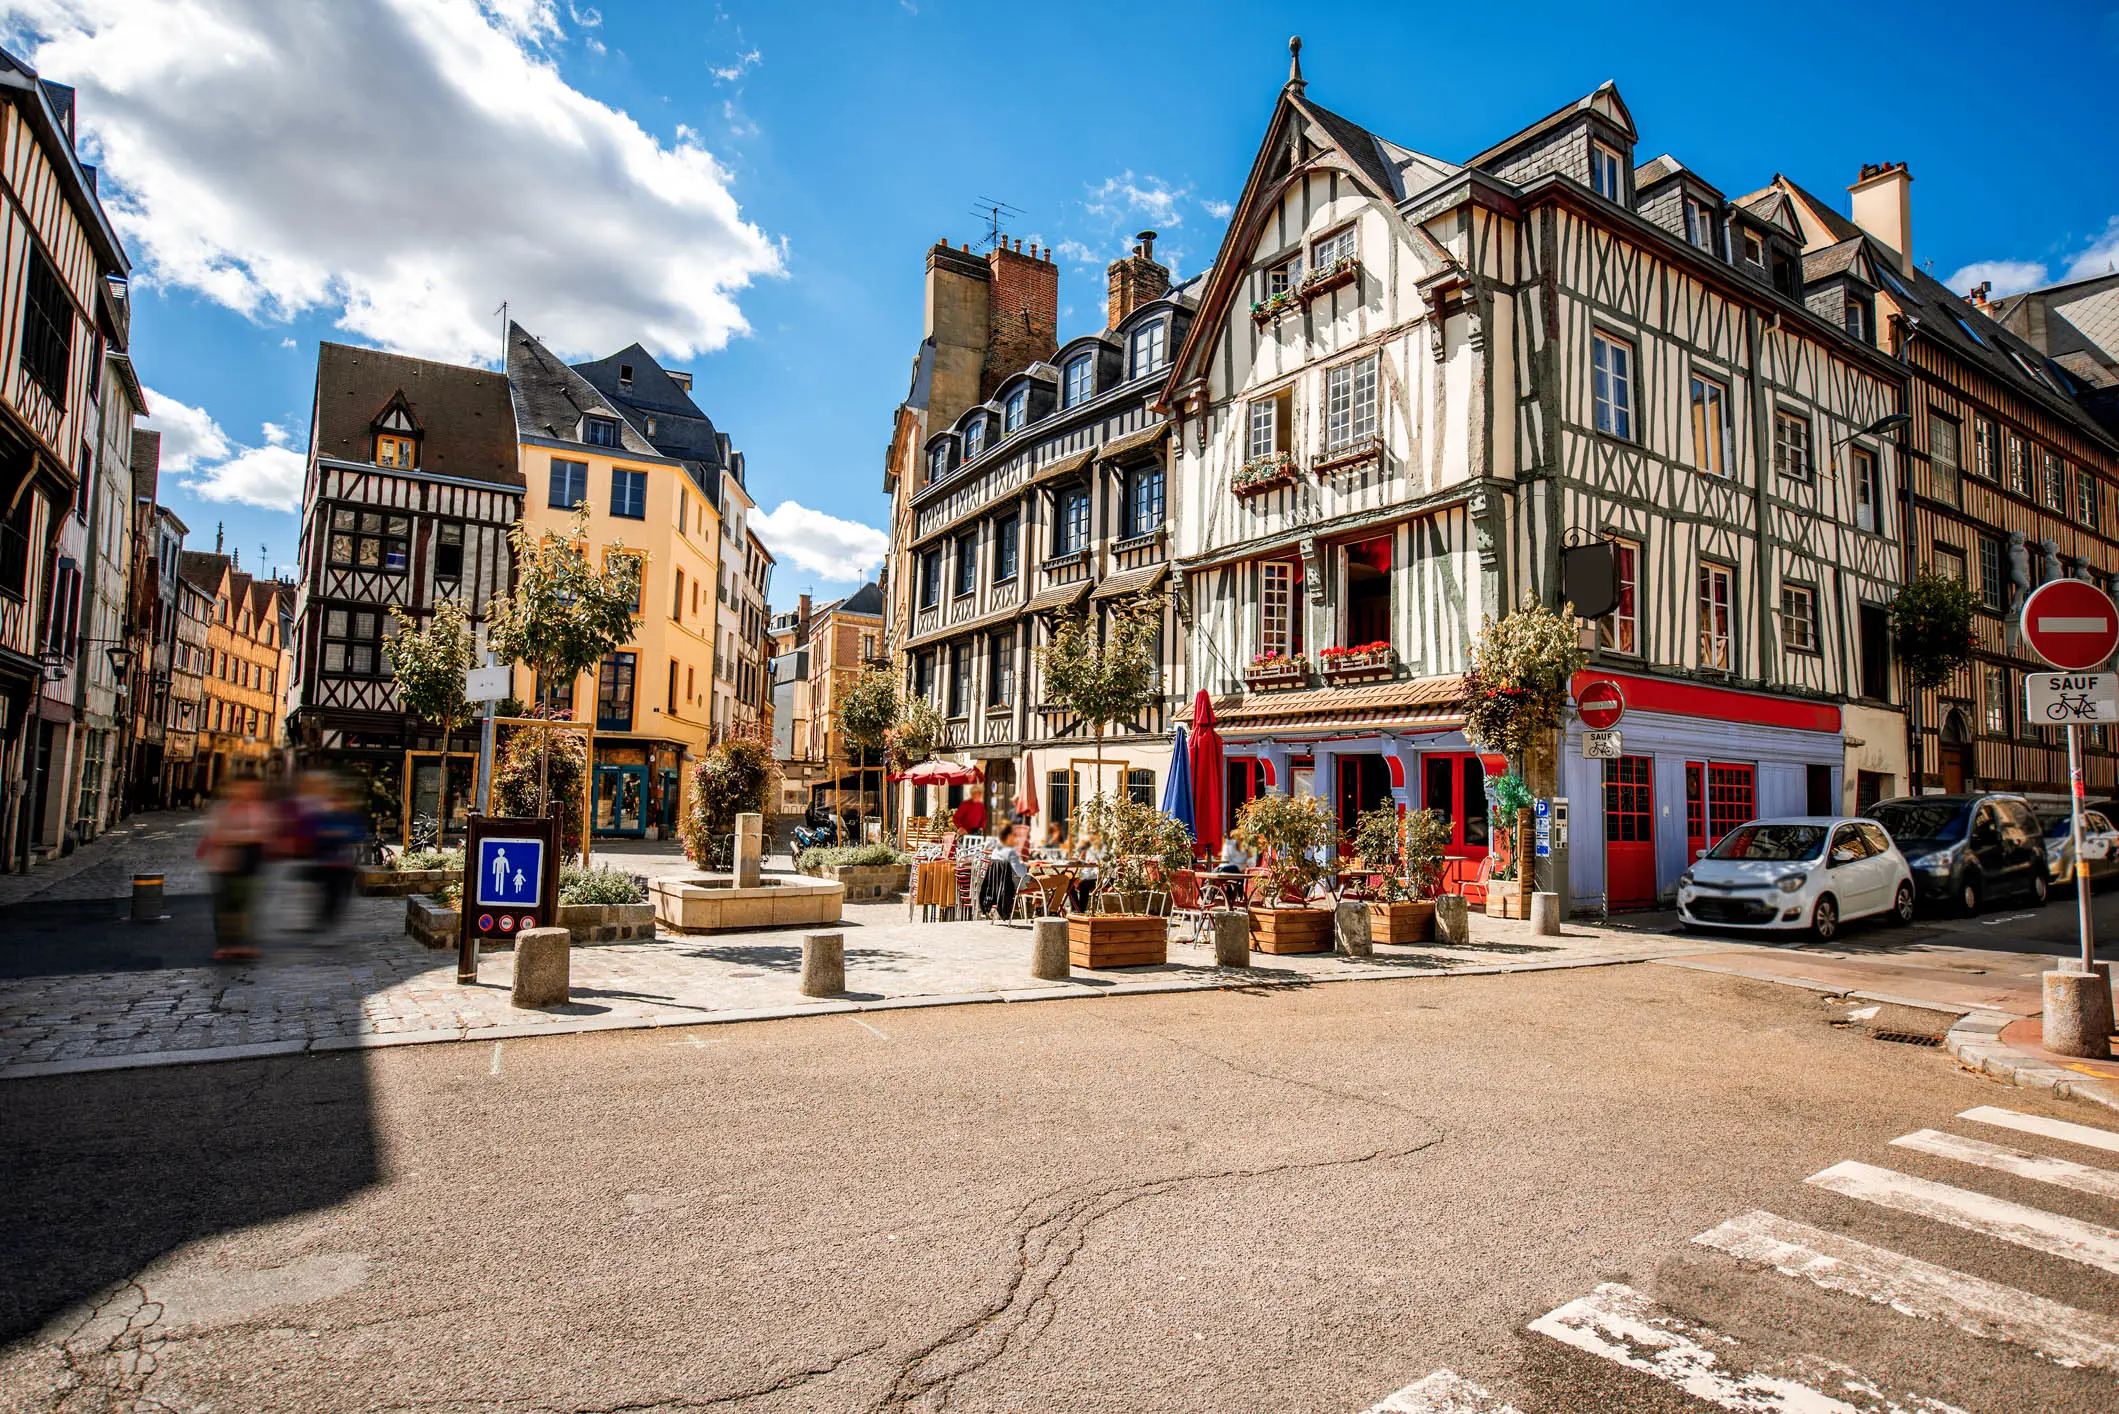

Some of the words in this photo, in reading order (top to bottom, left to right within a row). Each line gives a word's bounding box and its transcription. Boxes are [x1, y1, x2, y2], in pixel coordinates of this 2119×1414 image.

[2050, 677, 2098, 690] SAUF
[1590, 733, 1612, 741] SAUF
[1538, 803, 1546, 815] P
